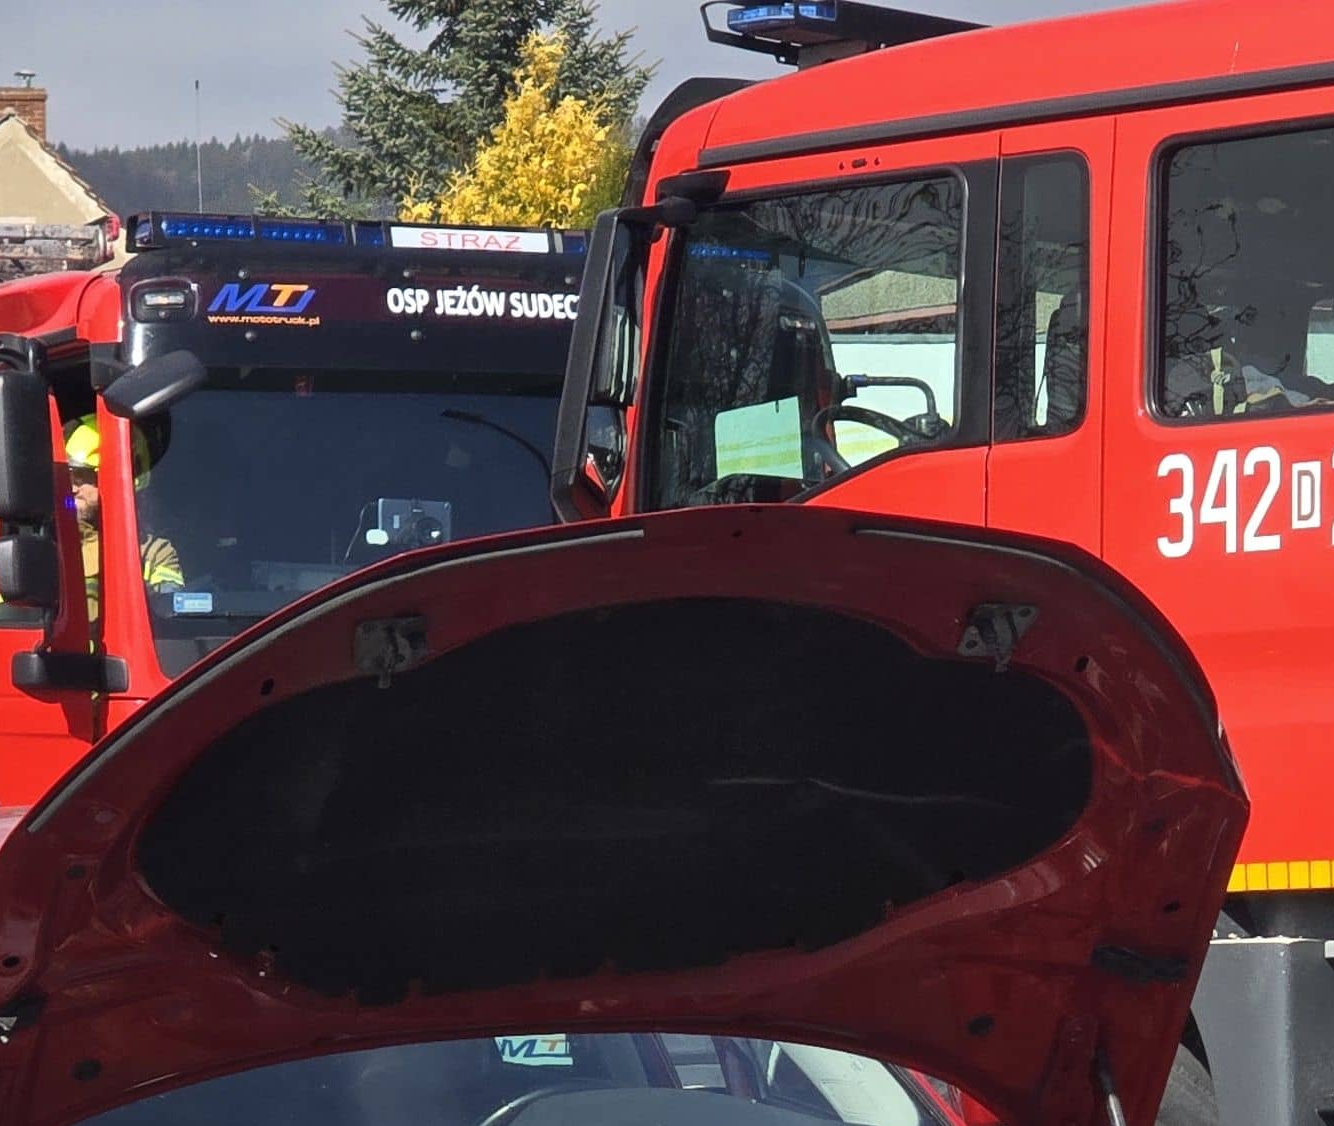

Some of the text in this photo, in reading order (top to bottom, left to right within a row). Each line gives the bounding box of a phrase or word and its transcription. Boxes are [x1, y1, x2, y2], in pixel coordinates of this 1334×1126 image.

[387, 288, 429, 314] OSP
[435, 285, 505, 316] JEŻÓW
[207, 315, 320, 327] www.mototruck.pl
